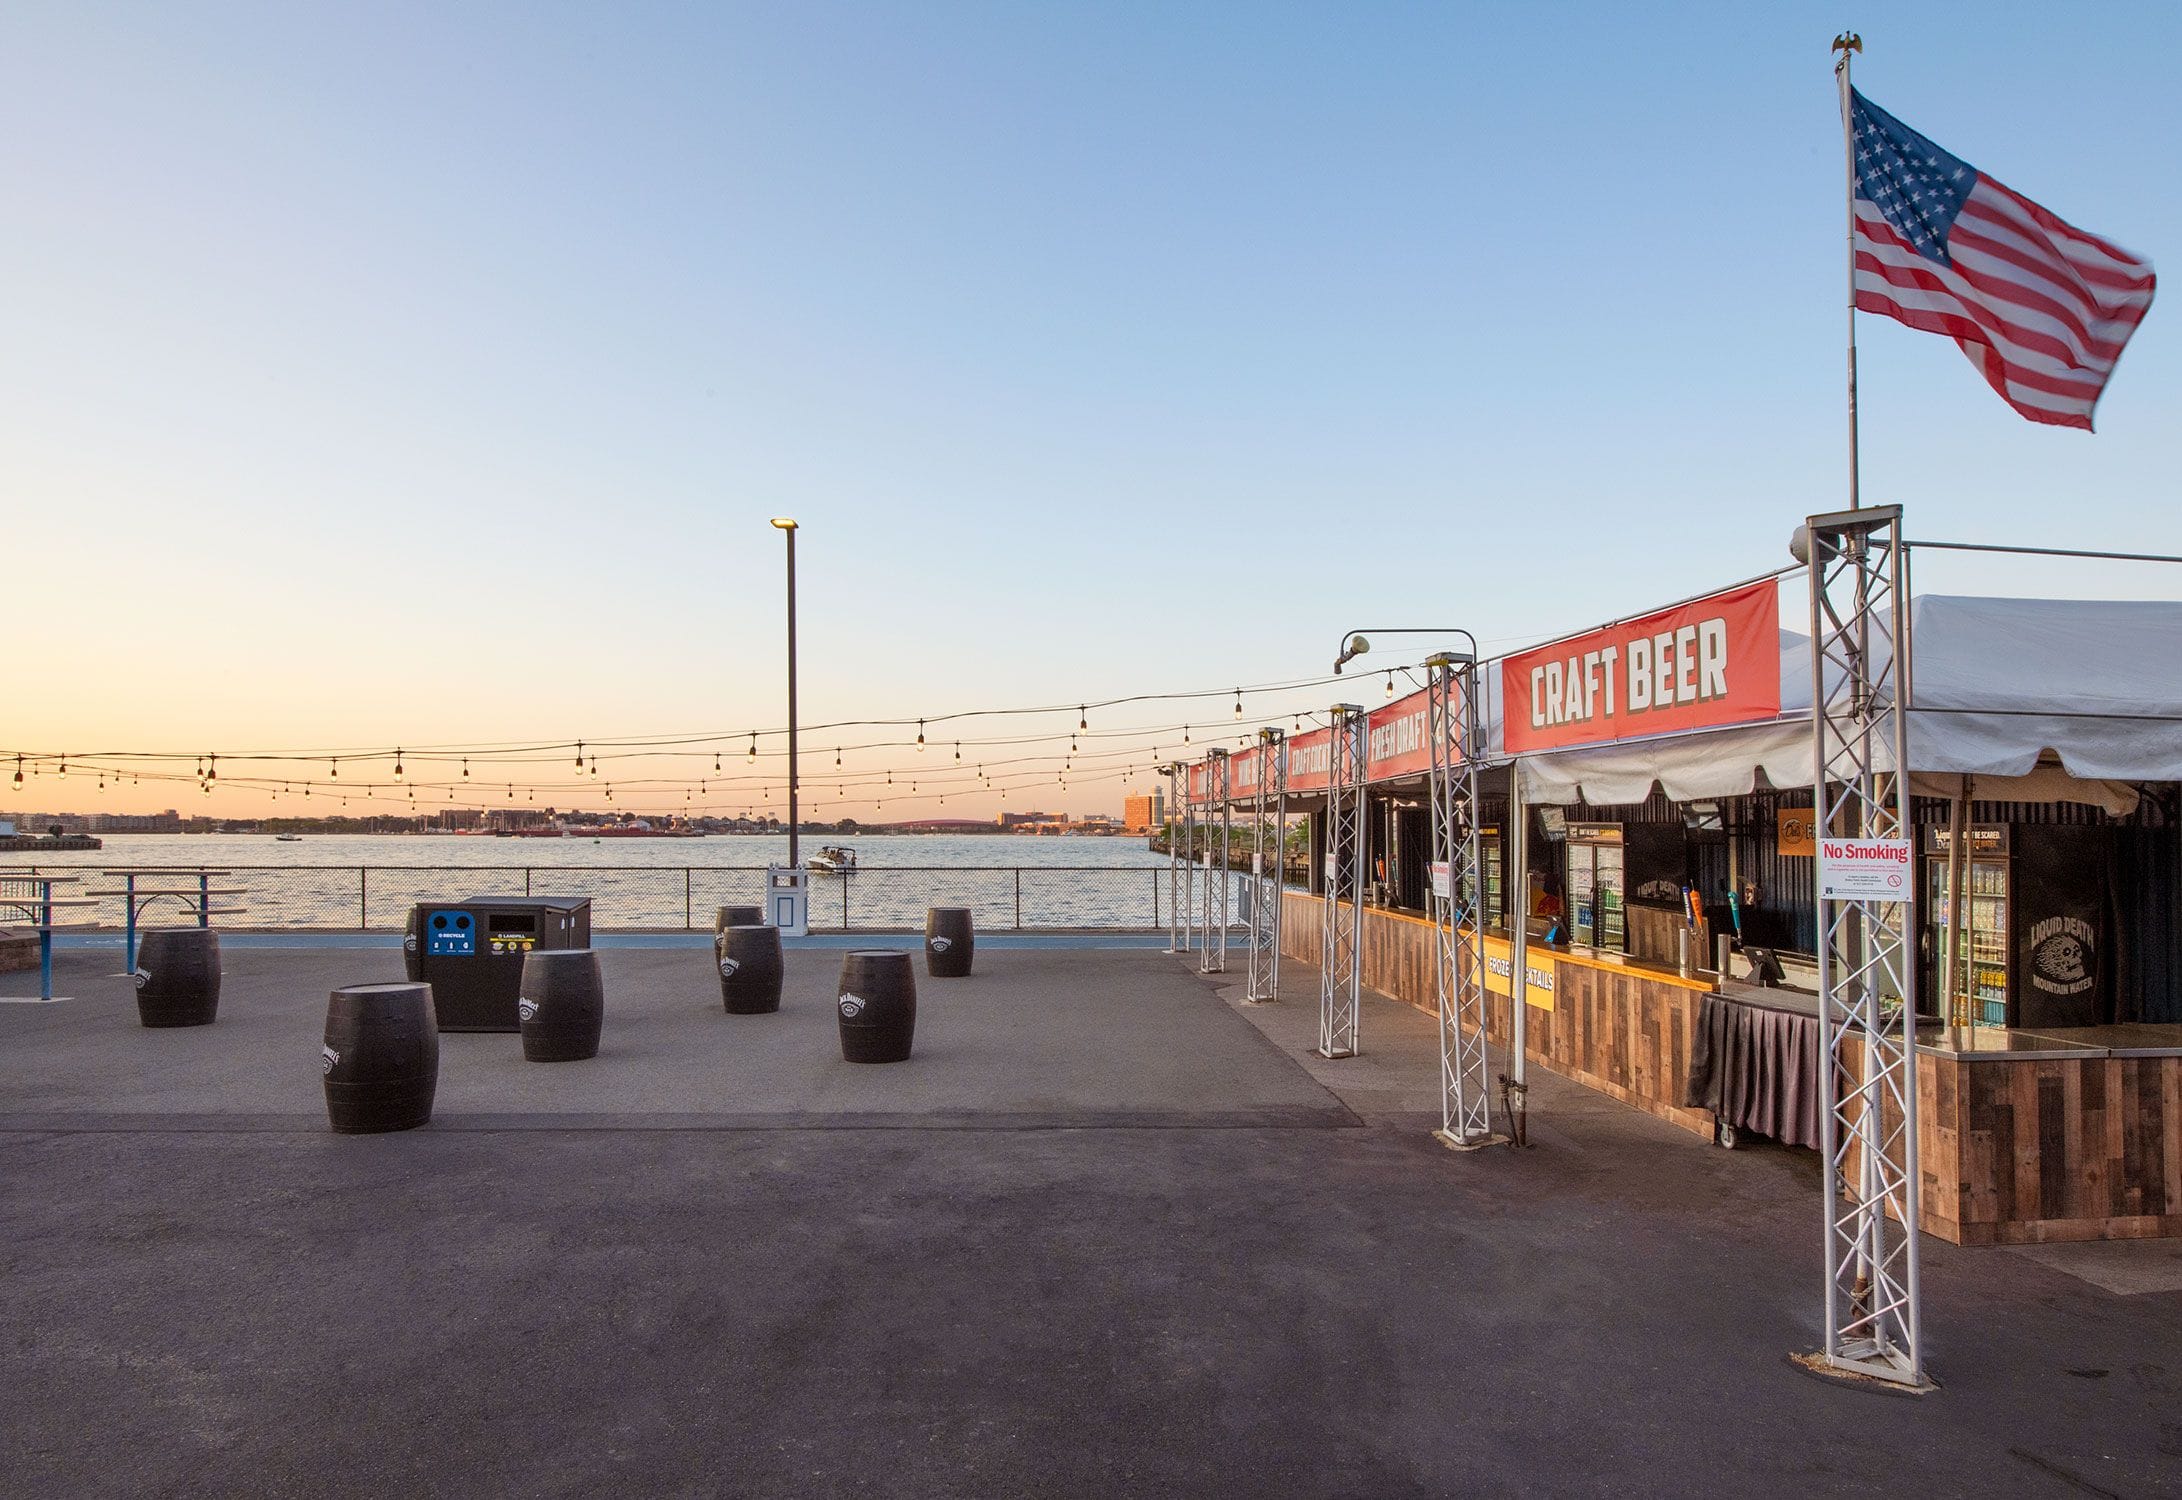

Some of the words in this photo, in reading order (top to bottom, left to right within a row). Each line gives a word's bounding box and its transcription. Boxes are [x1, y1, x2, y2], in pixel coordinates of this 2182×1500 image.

[1531, 646, 1618, 729] CRAFT
[1627, 617, 1728, 714] BEER
[1371, 721, 1396, 762] FRESH
[1397, 711, 1426, 754] DRAFT
[1824, 843, 1843, 858] No
[1845, 843, 1908, 864] Smoking
[2031, 916, 2062, 950] LIQUID
[2063, 916, 2094, 952] DEATH
[1489, 956, 1512, 977] FROZE
[2033, 974, 2069, 995] MOUNTAIN
[2070, 976, 2093, 993] WATER
